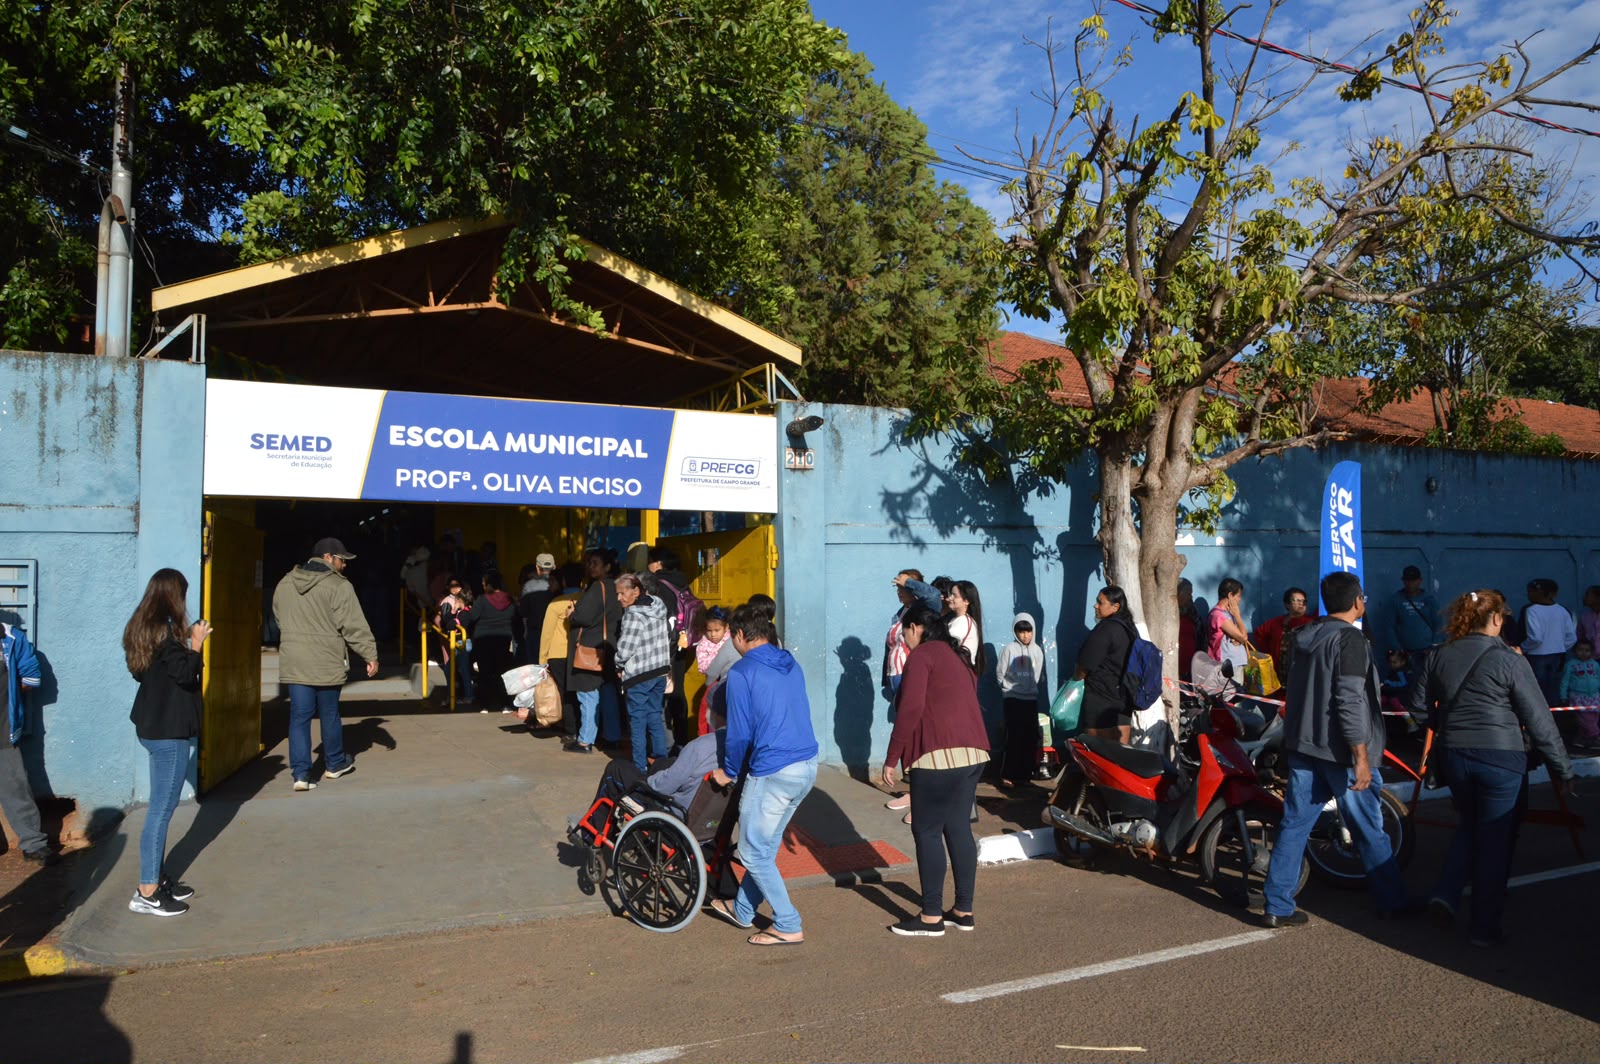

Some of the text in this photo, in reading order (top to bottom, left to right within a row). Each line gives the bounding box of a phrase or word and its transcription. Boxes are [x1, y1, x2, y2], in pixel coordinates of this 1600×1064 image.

[250, 433, 332, 452] SEMED
[389, 425, 649, 459] ESCOLA MUNICIPAL
[300, 461, 332, 469] Educação
[700, 461, 755, 475] PREFCG
[483, 472, 553, 494] OLIVA
[558, 476, 642, 496] ENCISO
[1337, 487, 1357, 573] TAR
